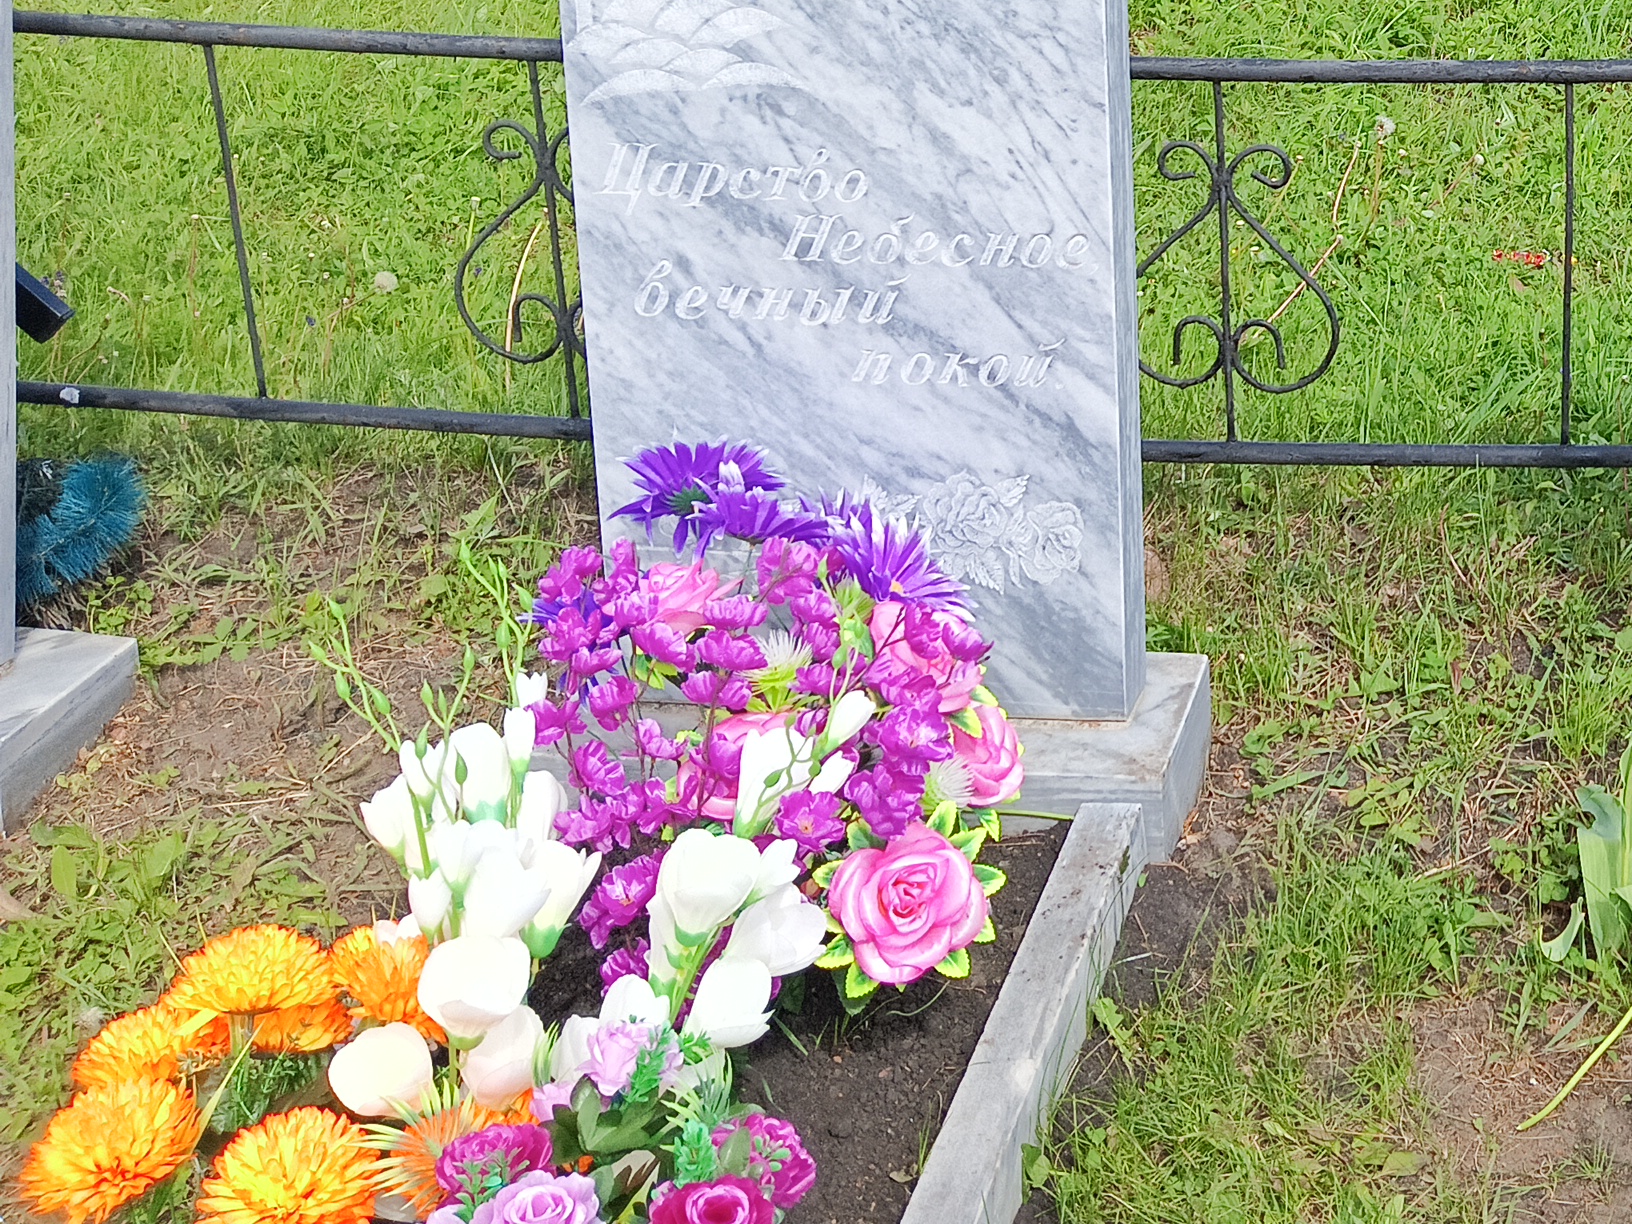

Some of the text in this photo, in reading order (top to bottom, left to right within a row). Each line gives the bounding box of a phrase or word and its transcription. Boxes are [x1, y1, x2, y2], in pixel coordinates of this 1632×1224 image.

[592, 141, 870, 217] Царство
[779, 213, 1100, 275] Небесное,
[633, 257, 912, 326] вечный
